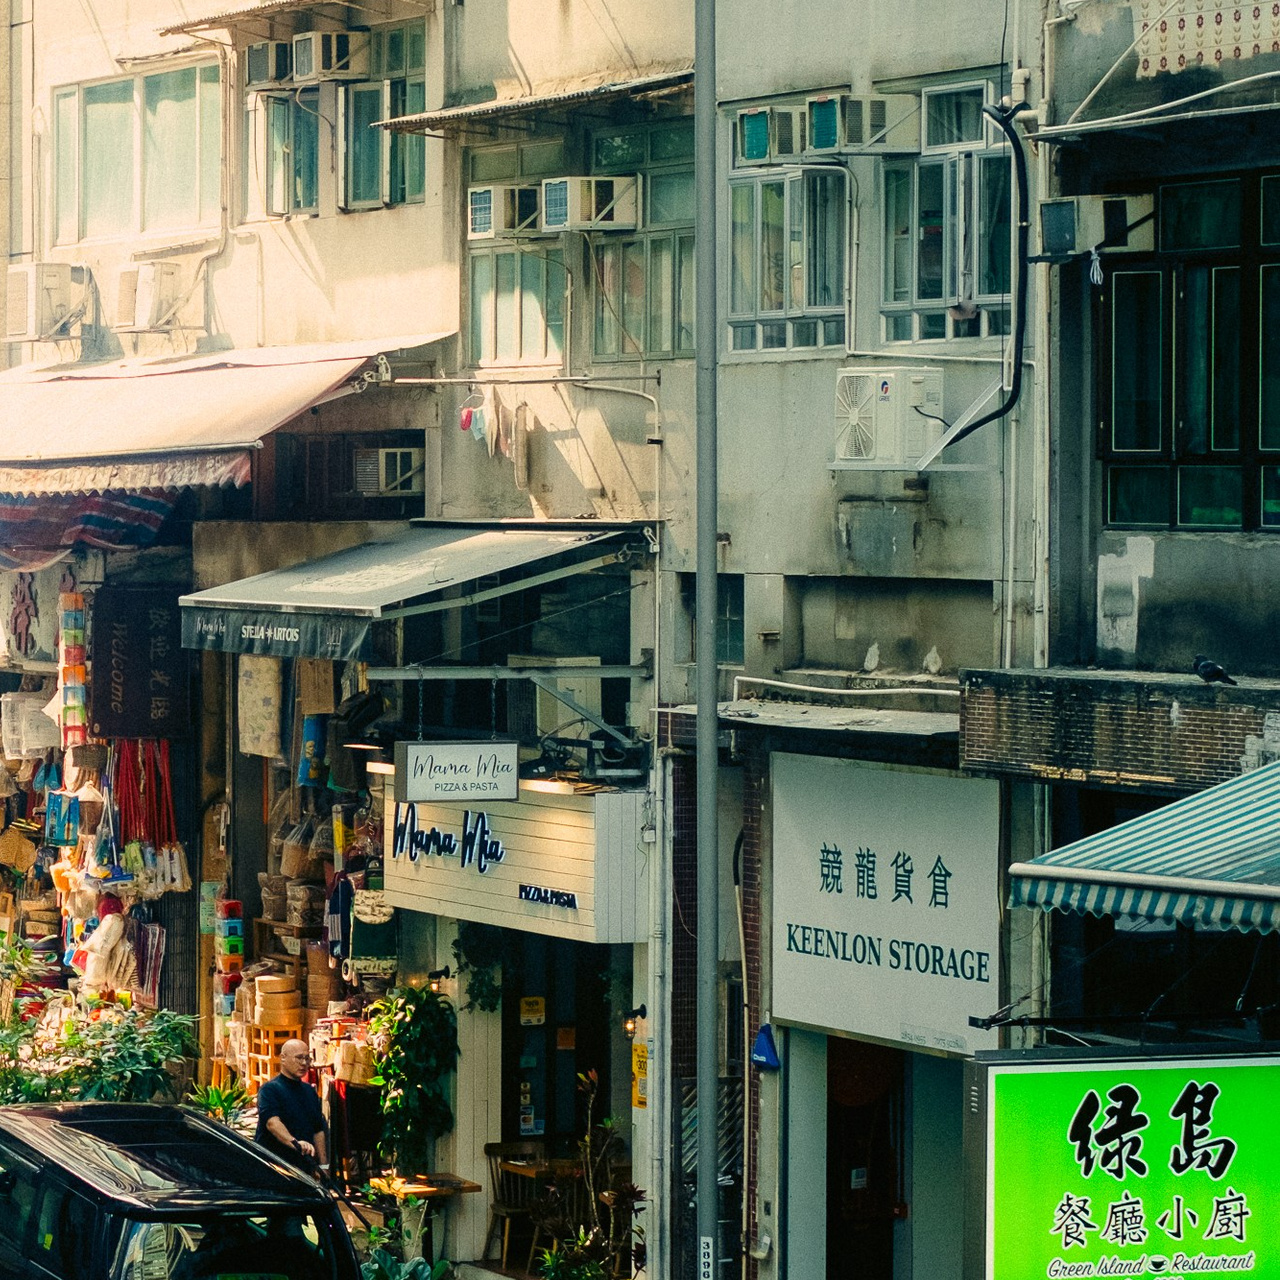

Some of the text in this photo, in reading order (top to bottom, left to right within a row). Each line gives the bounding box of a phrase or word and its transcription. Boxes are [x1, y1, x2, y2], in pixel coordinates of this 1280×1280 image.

[241, 624, 299, 642] STELLA ARTOIS
[111, 622, 128, 714] Welcome
[413, 753, 513, 779] Mama Mia
[434, 783, 460, 792] PIZZA
[470, 782, 499, 791] PASTA
[393, 802, 505, 874] Mama Mia
[787, 923, 990, 983] KEENLON STORAGE
[1051, 1188, 1251, 1248] 餐廳小廚
[1048, 1252, 1254, 1277] Green Island Restaurant
